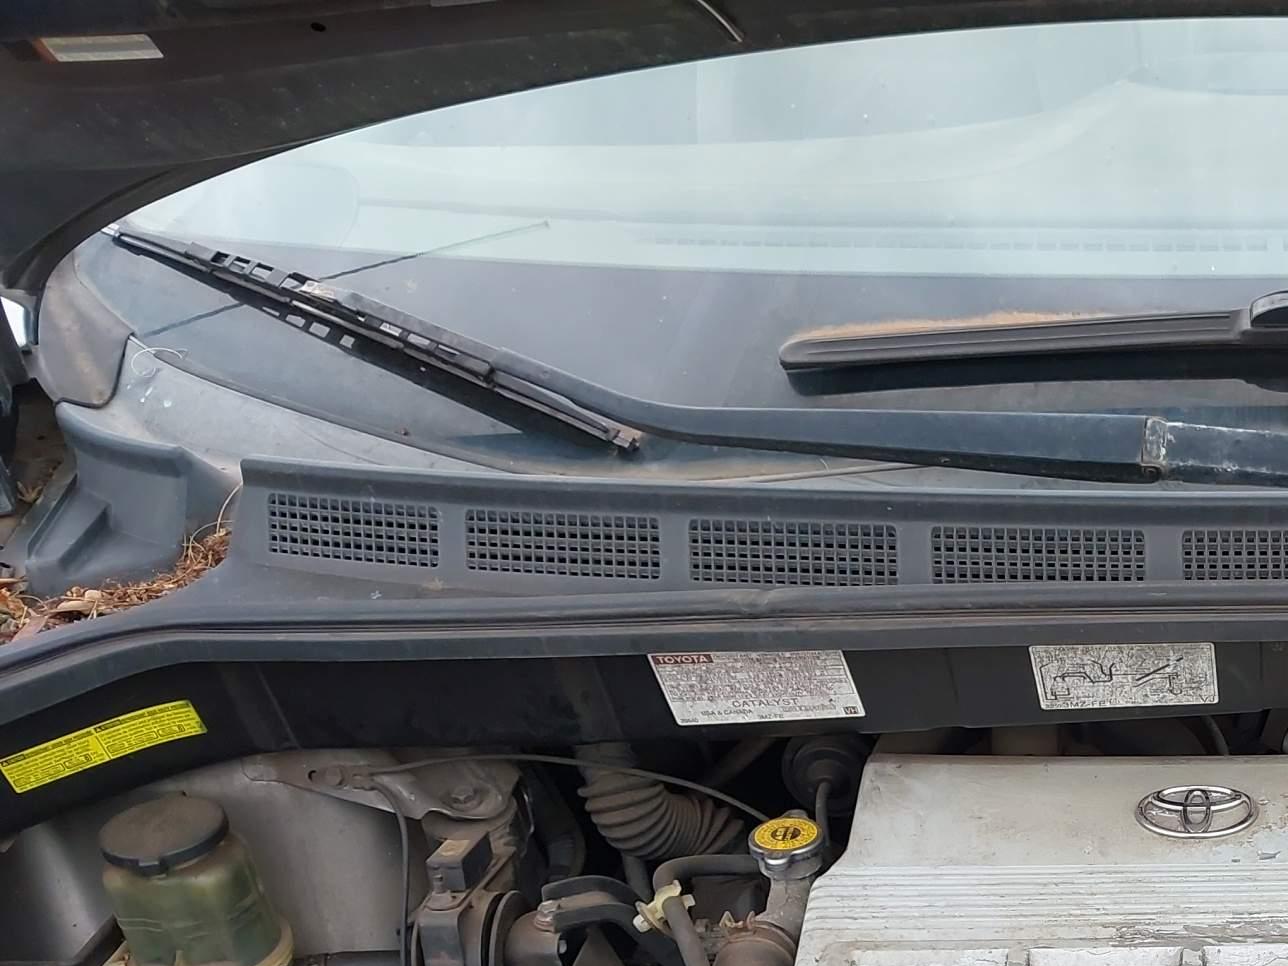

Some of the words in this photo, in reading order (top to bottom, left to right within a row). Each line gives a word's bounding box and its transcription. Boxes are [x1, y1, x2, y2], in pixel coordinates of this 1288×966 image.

[656, 655, 708, 664] TOYOTA
[732, 698, 800, 707] CATALYST
[844, 706, 858, 714] VH
